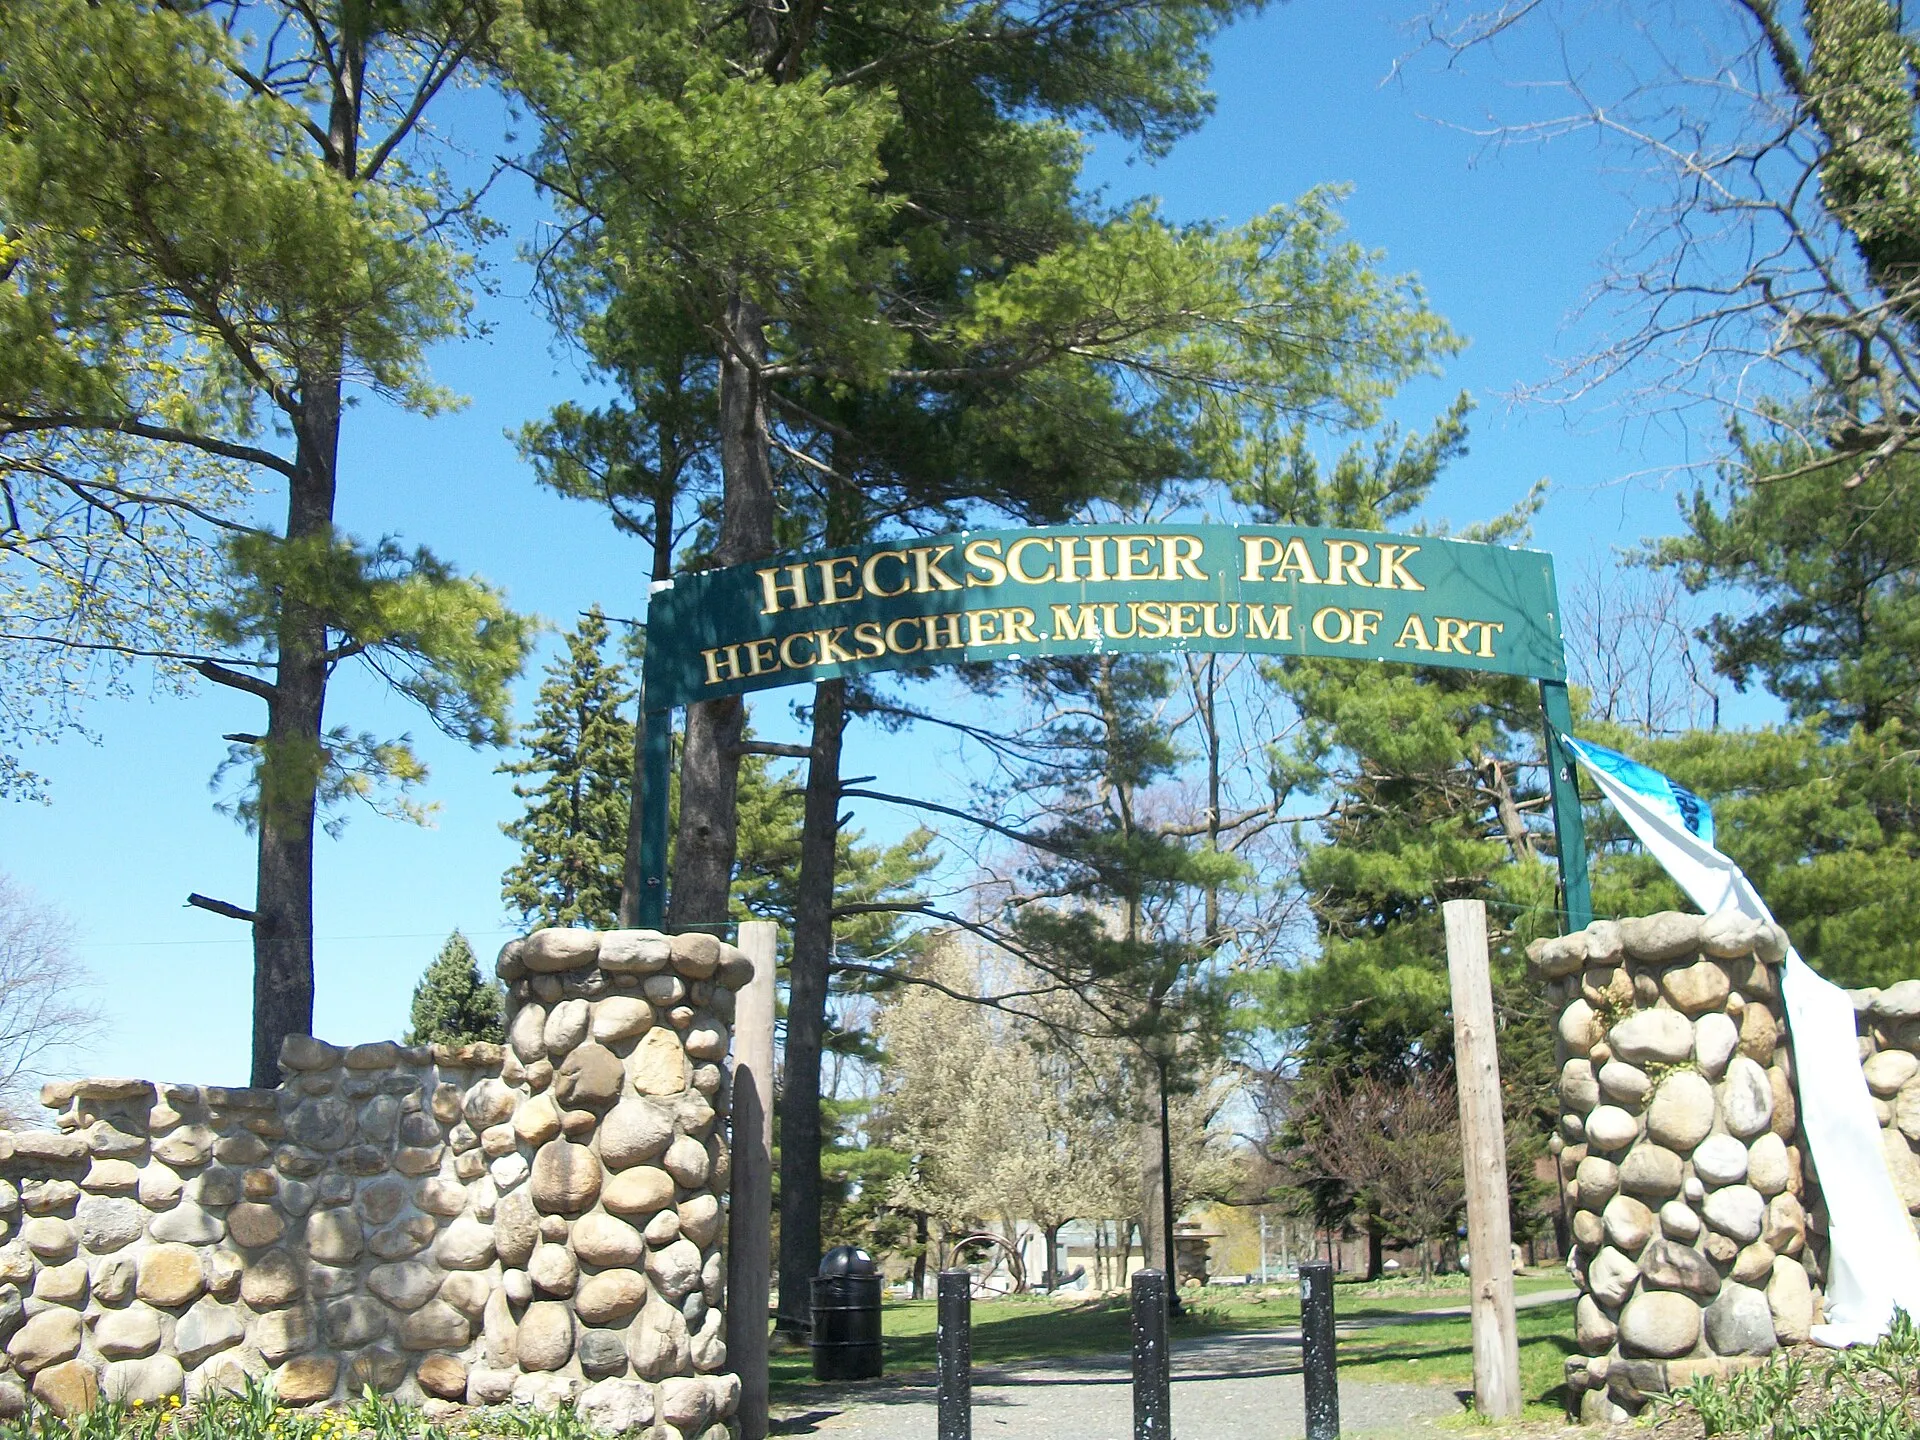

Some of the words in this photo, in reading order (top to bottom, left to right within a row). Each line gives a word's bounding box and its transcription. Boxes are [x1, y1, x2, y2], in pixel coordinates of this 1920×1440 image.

[756, 535, 1208, 614] HECKSCHER
[1239, 536, 1425, 591] PARK
[702, 606, 1040, 685] HECKSCHER
[1051, 602, 1293, 641] MUSEUM
[1312, 607, 1383, 645] OF
[1394, 614, 1503, 658] ART
